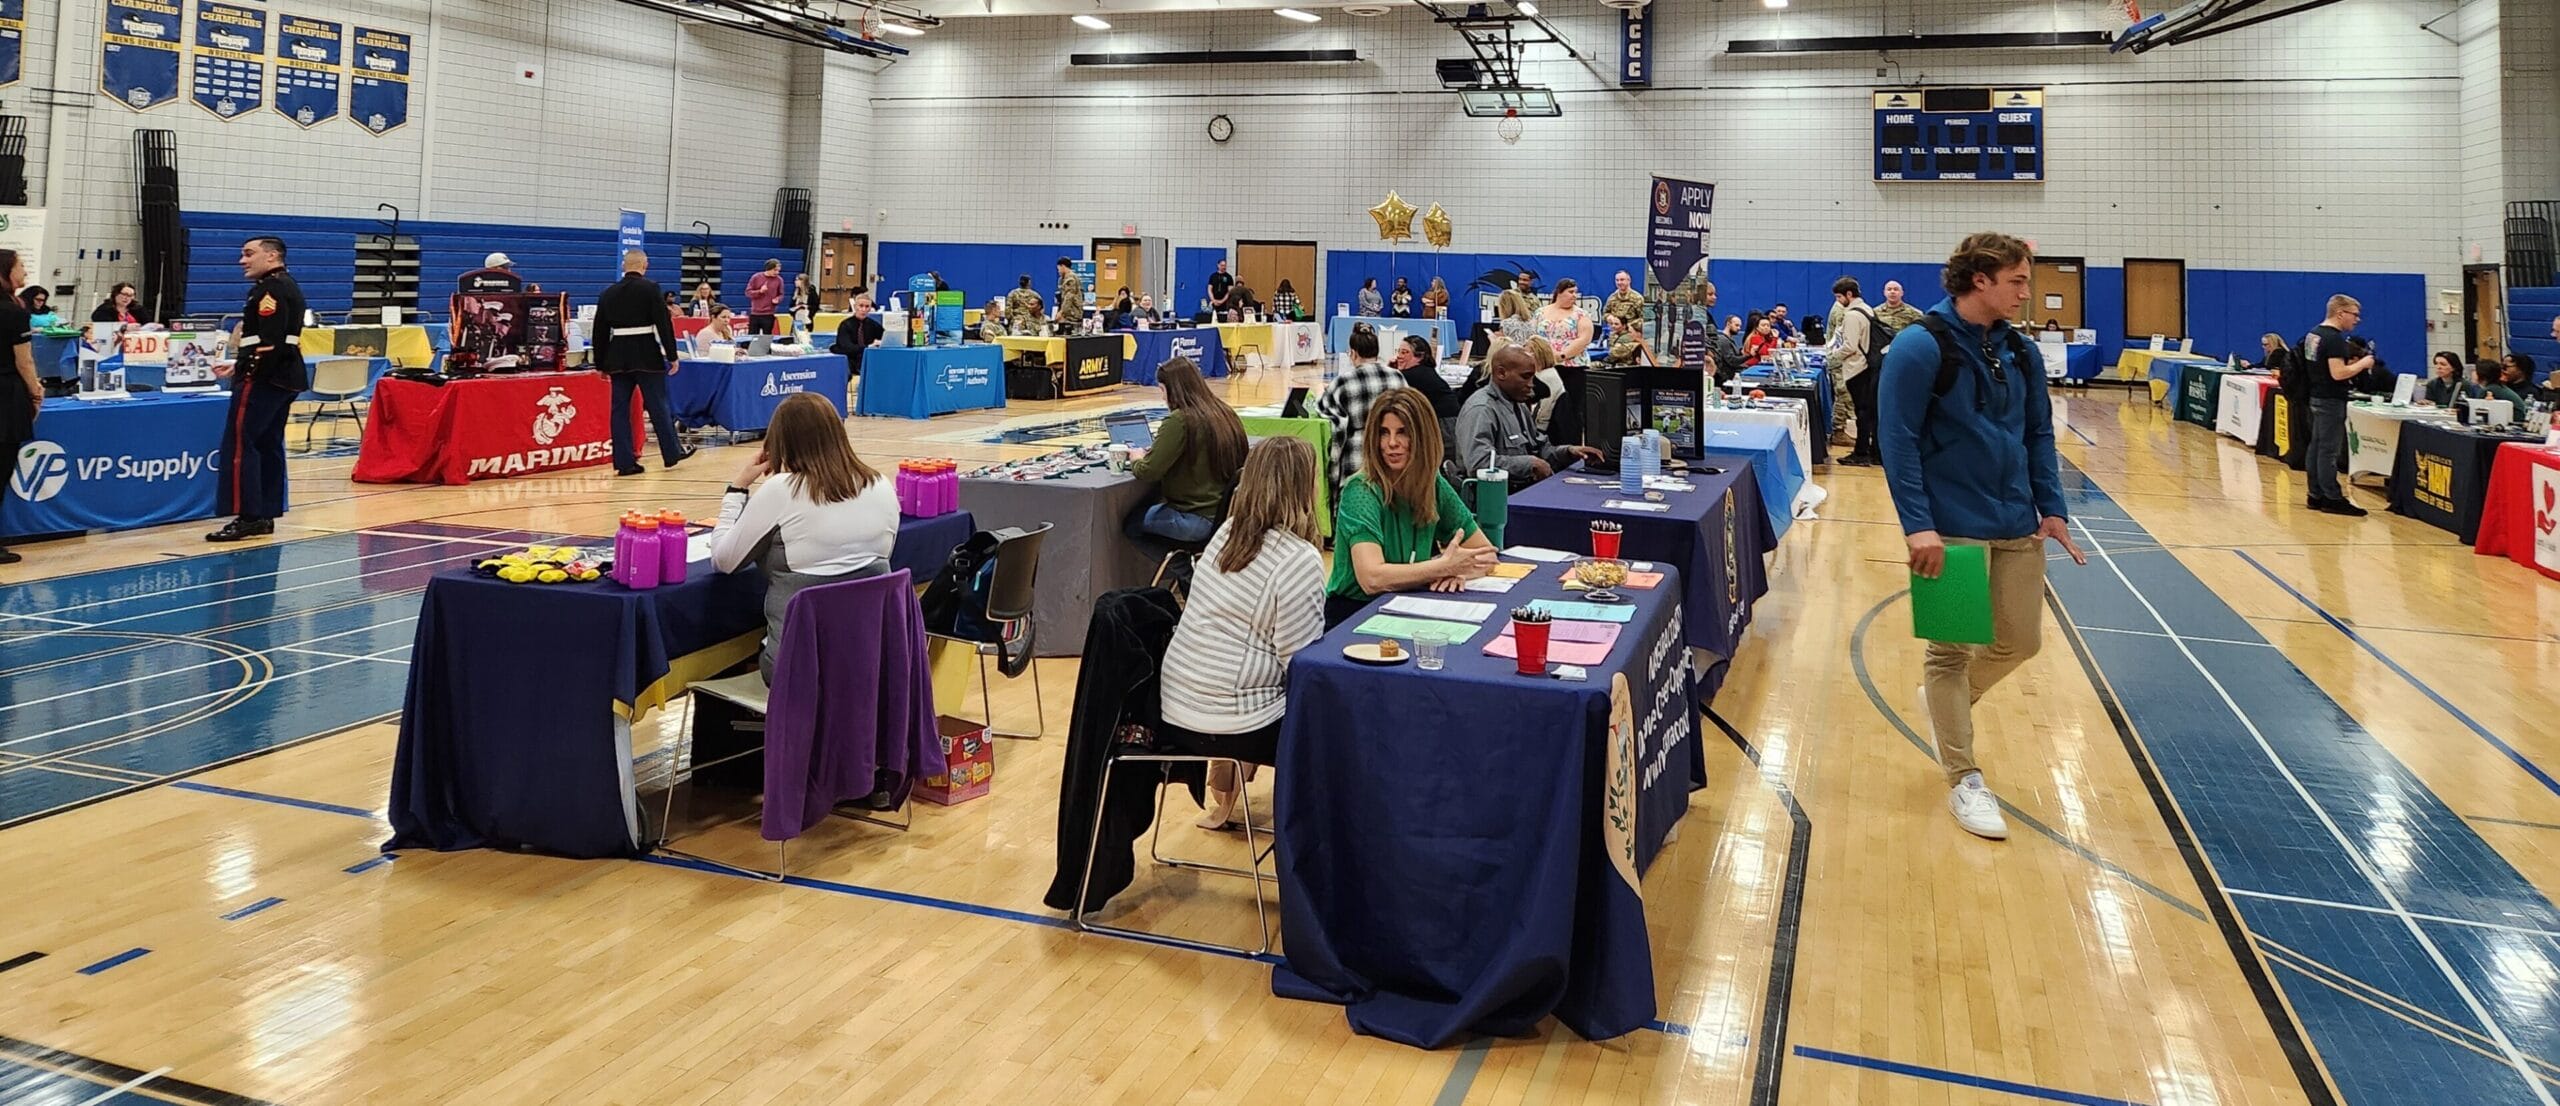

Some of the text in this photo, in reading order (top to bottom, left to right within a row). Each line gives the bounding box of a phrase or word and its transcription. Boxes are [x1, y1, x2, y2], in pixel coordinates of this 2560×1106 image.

[201, 11, 262, 28] CHAMPIONS
[282, 24, 338, 40] CHAMPIONS
[208, 49, 252, 60] WRESTLING
[289, 60, 328, 71] WRESTLING
[1886, 114, 1914, 124] HOME
[1998, 113, 2032, 123] GUEST
[1881, 172, 1903, 180] SCORE
[1939, 172, 1976, 180] ADVANTAGE
[1680, 186, 1712, 208] APPLY
[1688, 210, 1712, 230] NOW
[123, 337, 157, 354] EAD
[974, 368, 989, 376] Power
[1079, 356, 1104, 375] ARMY
[780, 369, 817, 382] Ascension
[967, 376, 988, 386] Authority
[467, 439, 613, 475] MARINES
[77, 456, 113, 481] VP
[116, 451, 203, 482] Supply
[2428, 461, 2452, 498] NAVY
